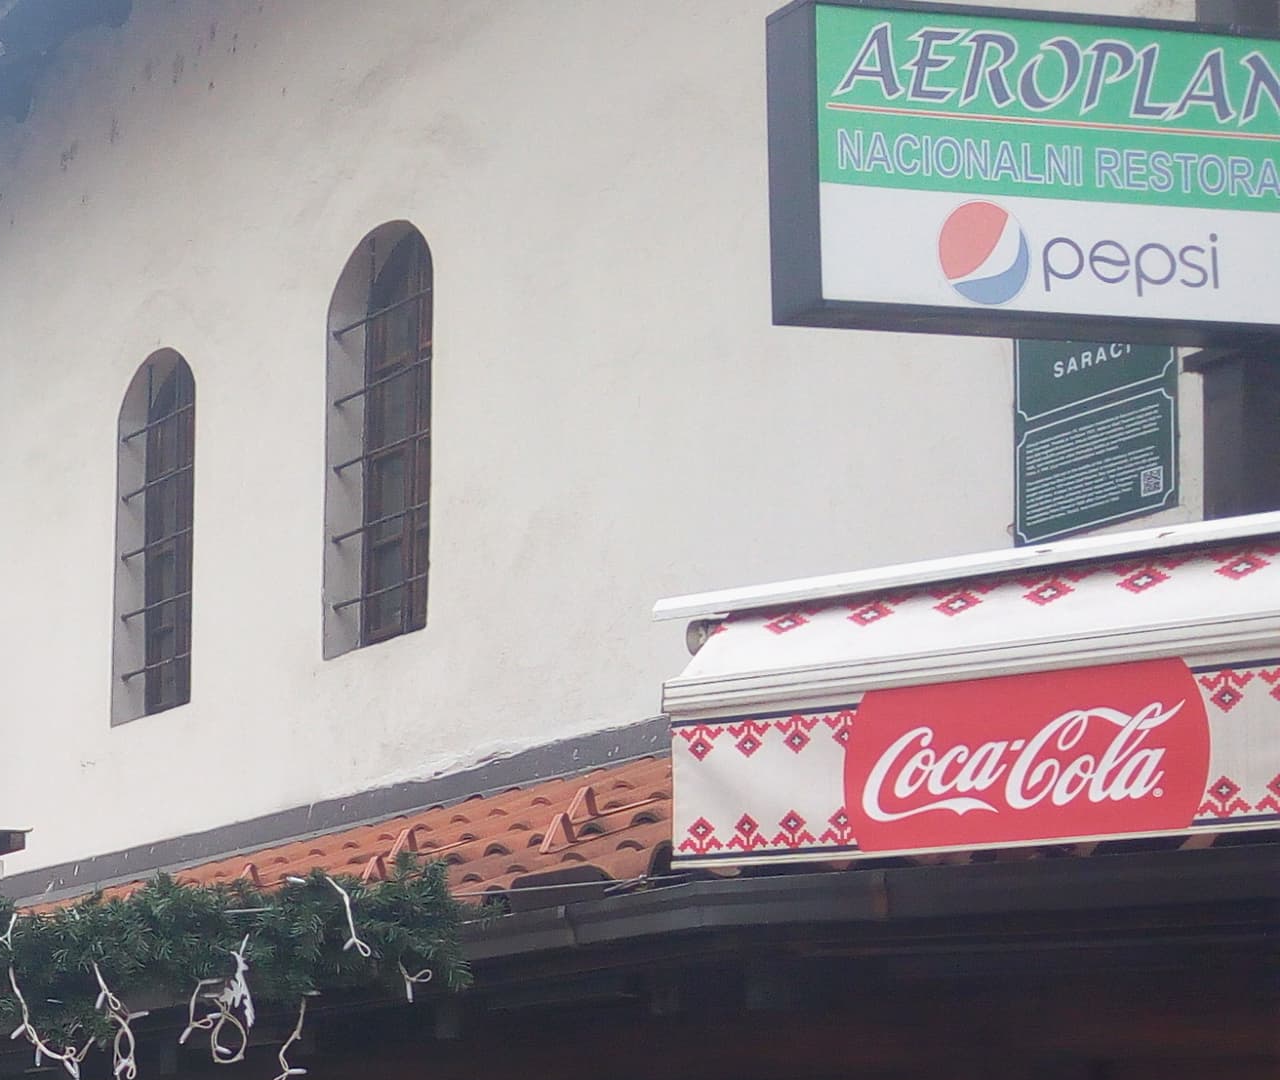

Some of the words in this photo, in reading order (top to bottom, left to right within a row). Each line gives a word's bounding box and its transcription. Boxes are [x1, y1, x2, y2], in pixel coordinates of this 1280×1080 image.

[831, 22, 1280, 126] AEROPLAN
[837, 128, 1083, 186] NACIONALNI
[1043, 233, 1219, 297] pepsi
[862, 699, 1185, 822] Coca-Cola
